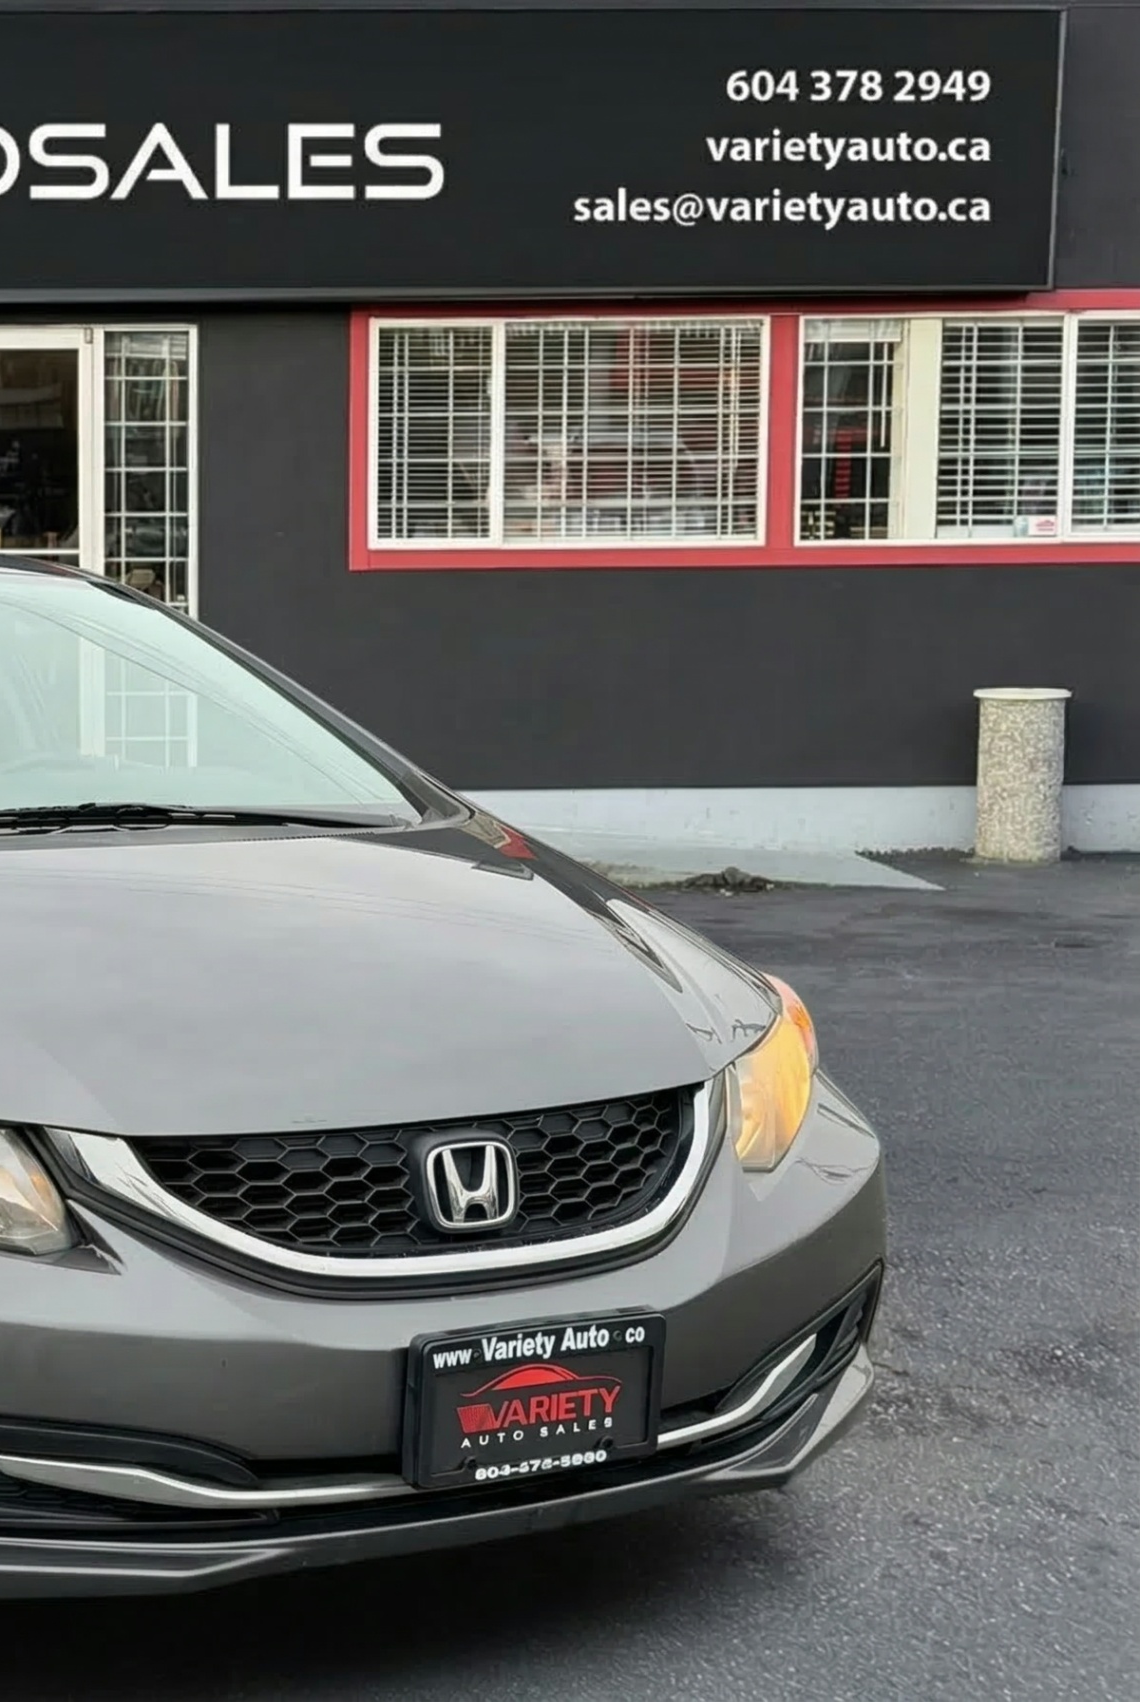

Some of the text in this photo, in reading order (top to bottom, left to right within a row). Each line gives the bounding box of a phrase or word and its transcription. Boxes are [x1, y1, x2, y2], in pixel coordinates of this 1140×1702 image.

[726, 70, 991, 102] 604 378 2949
[706, 127, 991, 171] varietyauto.ca
[573, 187, 991, 231] sales@varietyauto.ca
[433, 1348, 472, 1369] www
[481, 1332, 556, 1360] Variety
[560, 1324, 610, 1352] Auto
[457, 1385, 622, 1434] VARIETY
[460, 1416, 613, 1449] AUTO SALES
